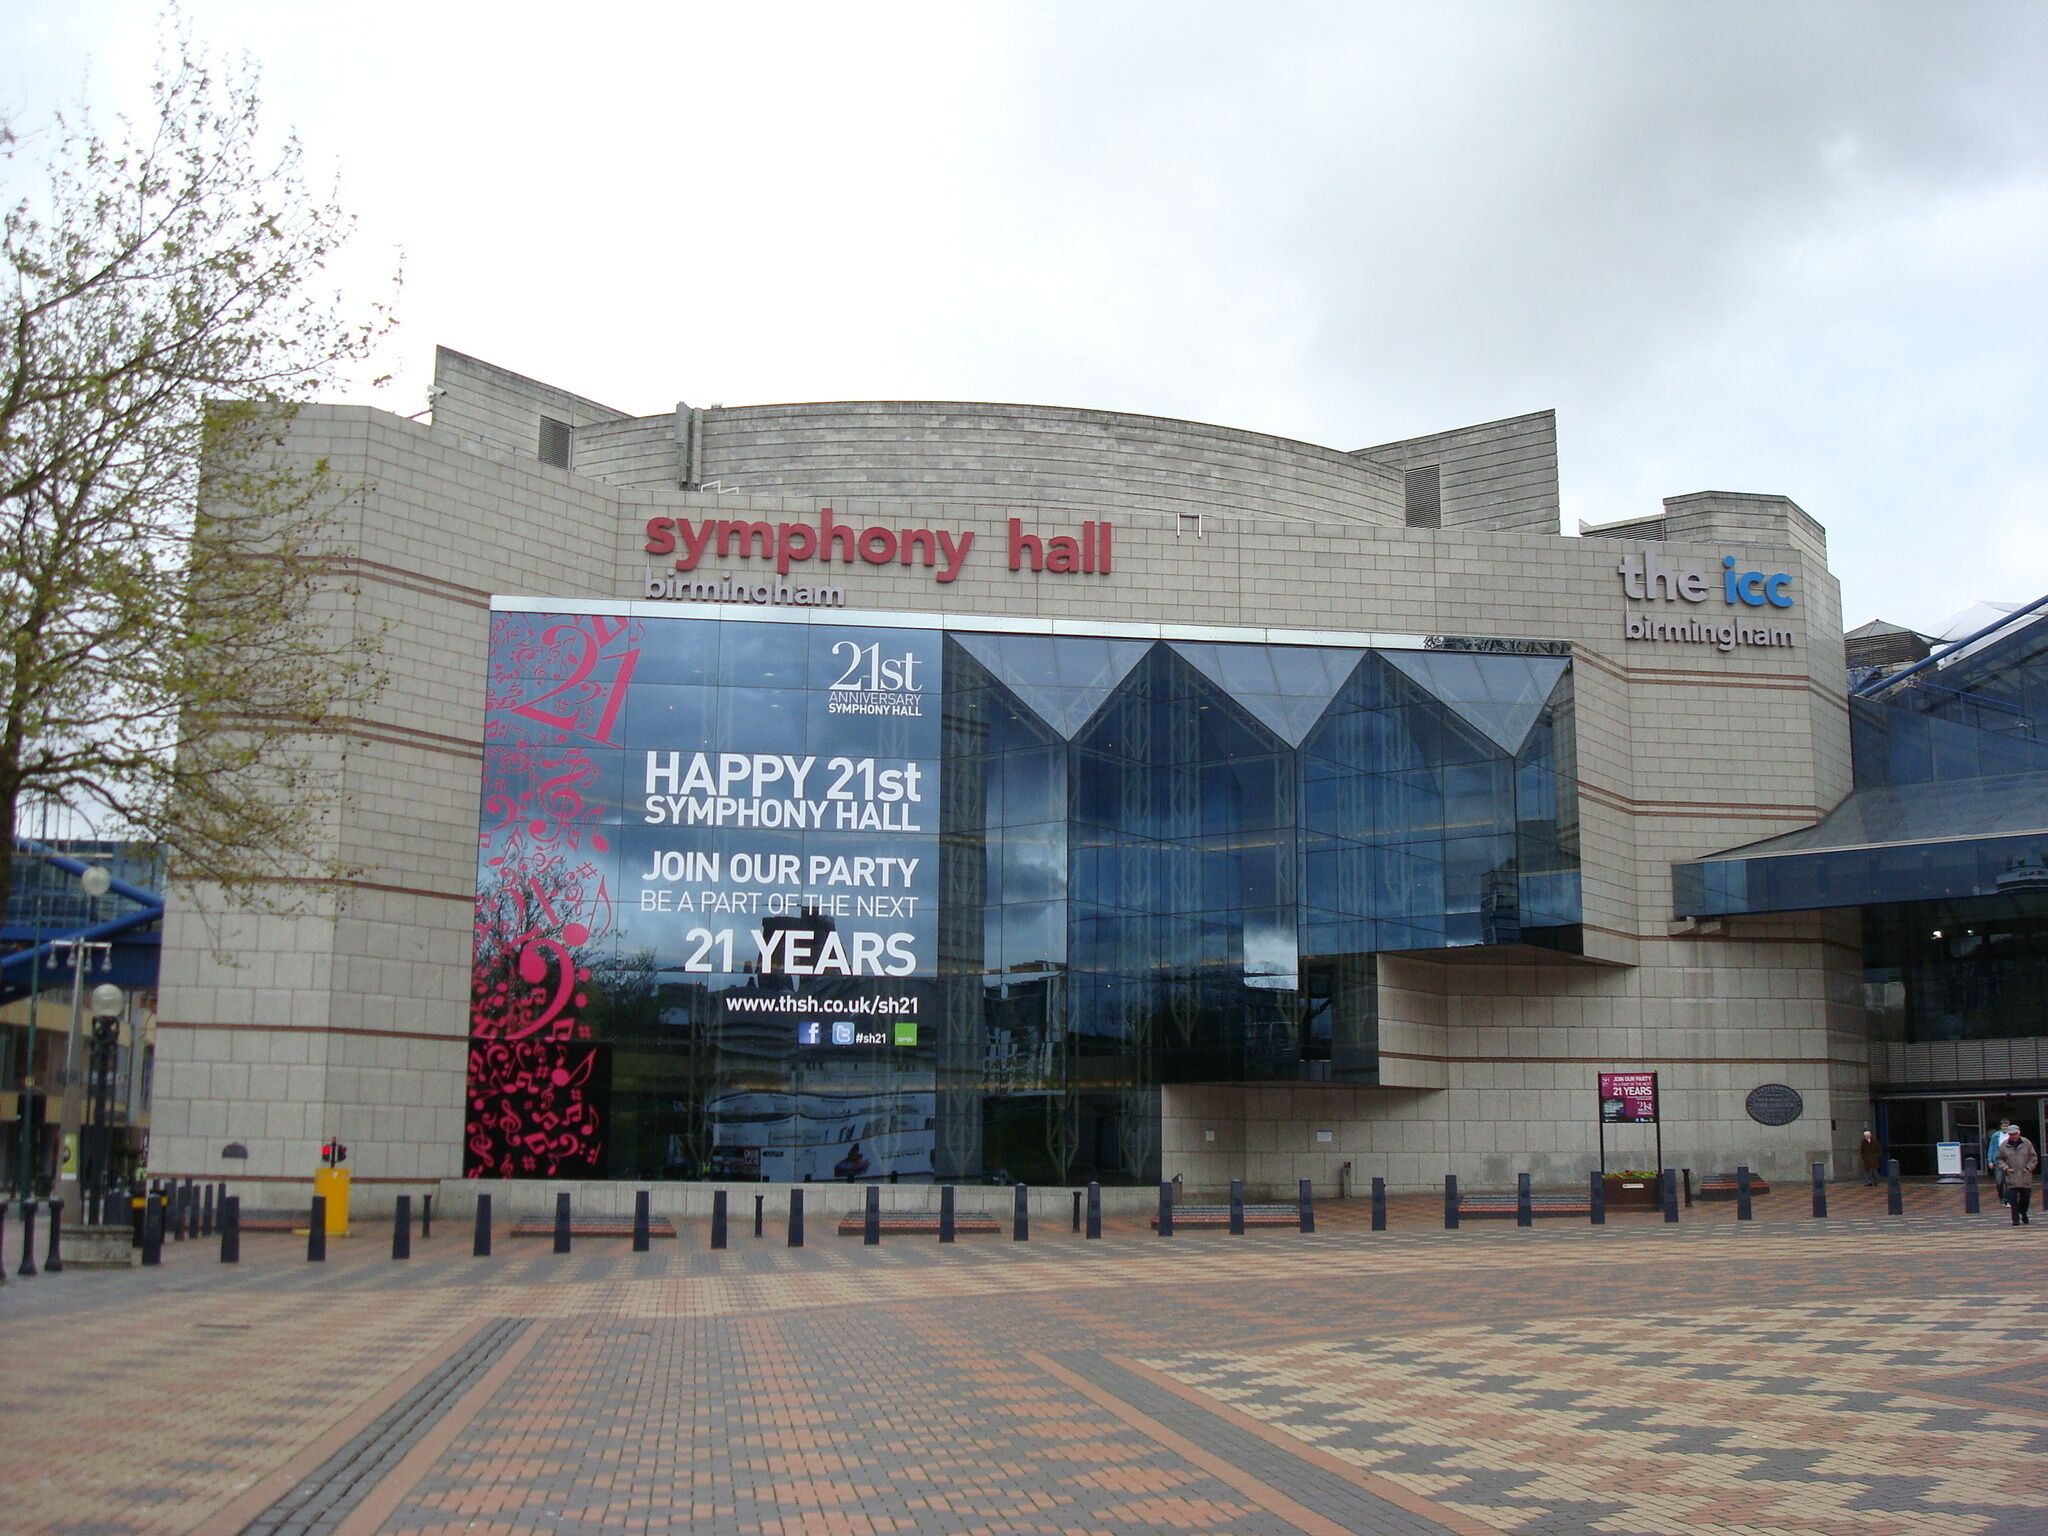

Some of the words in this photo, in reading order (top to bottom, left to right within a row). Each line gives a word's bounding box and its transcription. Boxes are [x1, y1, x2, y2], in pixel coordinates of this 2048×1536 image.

[645, 508, 975, 582] symphony
[1009, 518, 1112, 575] hall
[645, 567, 846, 607] birmingham
[1618, 550, 1709, 603] the
[1722, 555, 1794, 608] icc
[1625, 609, 1794, 651] birmingham
[829, 641, 922, 692] 21st
[829, 691, 921, 706] ANNIVERSARY
[829, 703, 891, 715] SYMPHONY
[892, 706, 922, 716] HALL
[646, 751, 816, 798] HAPPY
[827, 757, 921, 801] 21st
[644, 796, 829, 829] SYMPHONY
[837, 802, 921, 831] HALL
[642, 851, 719, 882] JOIN
[730, 853, 800, 884] OUR
[810, 856, 919, 888] PARTY
[641, 890, 672, 912] BE
[677, 891, 694, 912] A
[702, 891, 762, 914] PART
[768, 893, 799, 915] OF
[804, 894, 850, 916] THE
[857, 896, 919, 918] NEXT
[685, 928, 734, 972] 21
[751, 930, 917, 977] YEARS
[726, 994, 918, 1015] www.thsh.co.uk/sh21
[856, 1033, 886, 1044] #sh21
[1613, 1086, 1622, 1096] 21
[1623, 1086, 1652, 1096] YEARS
